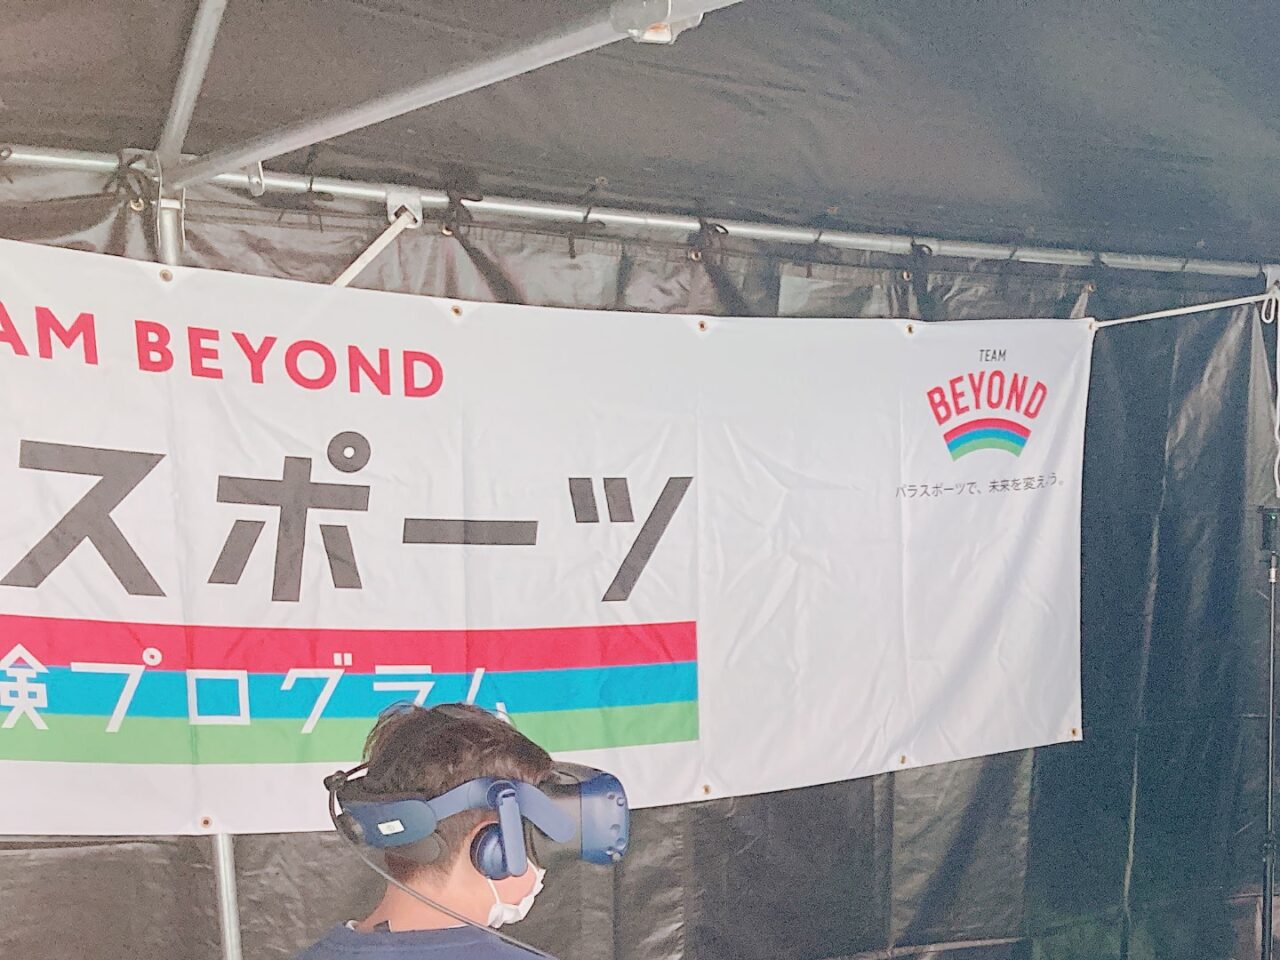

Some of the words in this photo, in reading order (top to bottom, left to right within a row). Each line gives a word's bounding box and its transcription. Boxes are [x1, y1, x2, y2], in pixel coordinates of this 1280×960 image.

[135, 318, 444, 398] BEYOND
[979, 349, 1007, 362] TEAM
[927, 369, 1048, 426] BEYOND
[0, 431, 694, 602] スポーツ
[0, 642, 514, 735] プログラ
